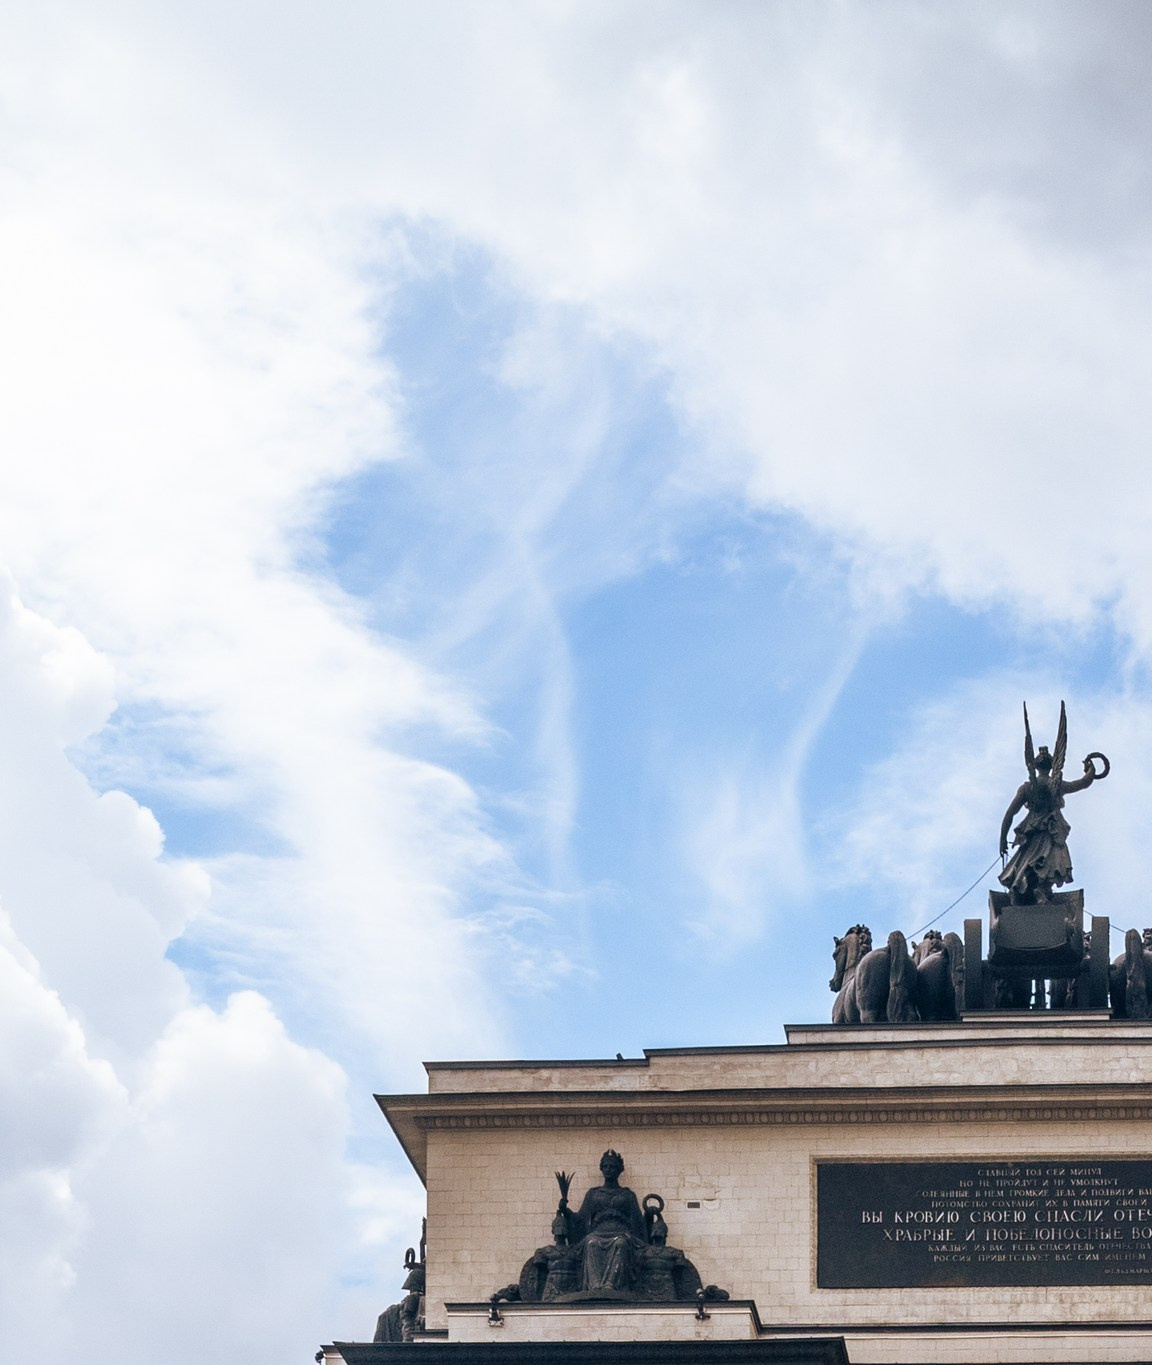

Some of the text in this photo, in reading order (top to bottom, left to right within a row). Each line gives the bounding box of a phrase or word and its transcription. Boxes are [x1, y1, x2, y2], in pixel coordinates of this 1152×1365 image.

[1046, 1168, 1065, 1176] СЕЙ
[1043, 1179, 1049, 1187] И
[1009, 1189, 1049, 1197] ГРОМКИЕ
[1081, 1188, 1087, 1197] И
[1091, 1188, 1134, 1196] ПОДВИГИ
[1045, 1199, 1058, 1207] ИХ
[1062, 1199, 1068, 1207] В
[1073, 1199, 1110, 1207] ПАМЯТИ
[862, 1210, 883, 1223] ВЫ
[894, 1210, 960, 1223] КРОВИЮ
[969, 1210, 1027, 1223] СВОЕЮ
[1034, 1209, 1104, 1223] СПАСЛИ
[883, 1227, 956, 1241] ХРАБРЫЕ
[965, 1228, 976, 1241] И
[986, 1227, 1123, 1241] ПОБЕДОНОСНЫЕ
[974, 1244, 986, 1252] ИЗ
[1039, 1243, 1095, 1251] СПАСИТЕЛЬ
[1055, 1253, 1073, 1261] ВАС
[1078, 1253, 1100, 1261] СИМ
